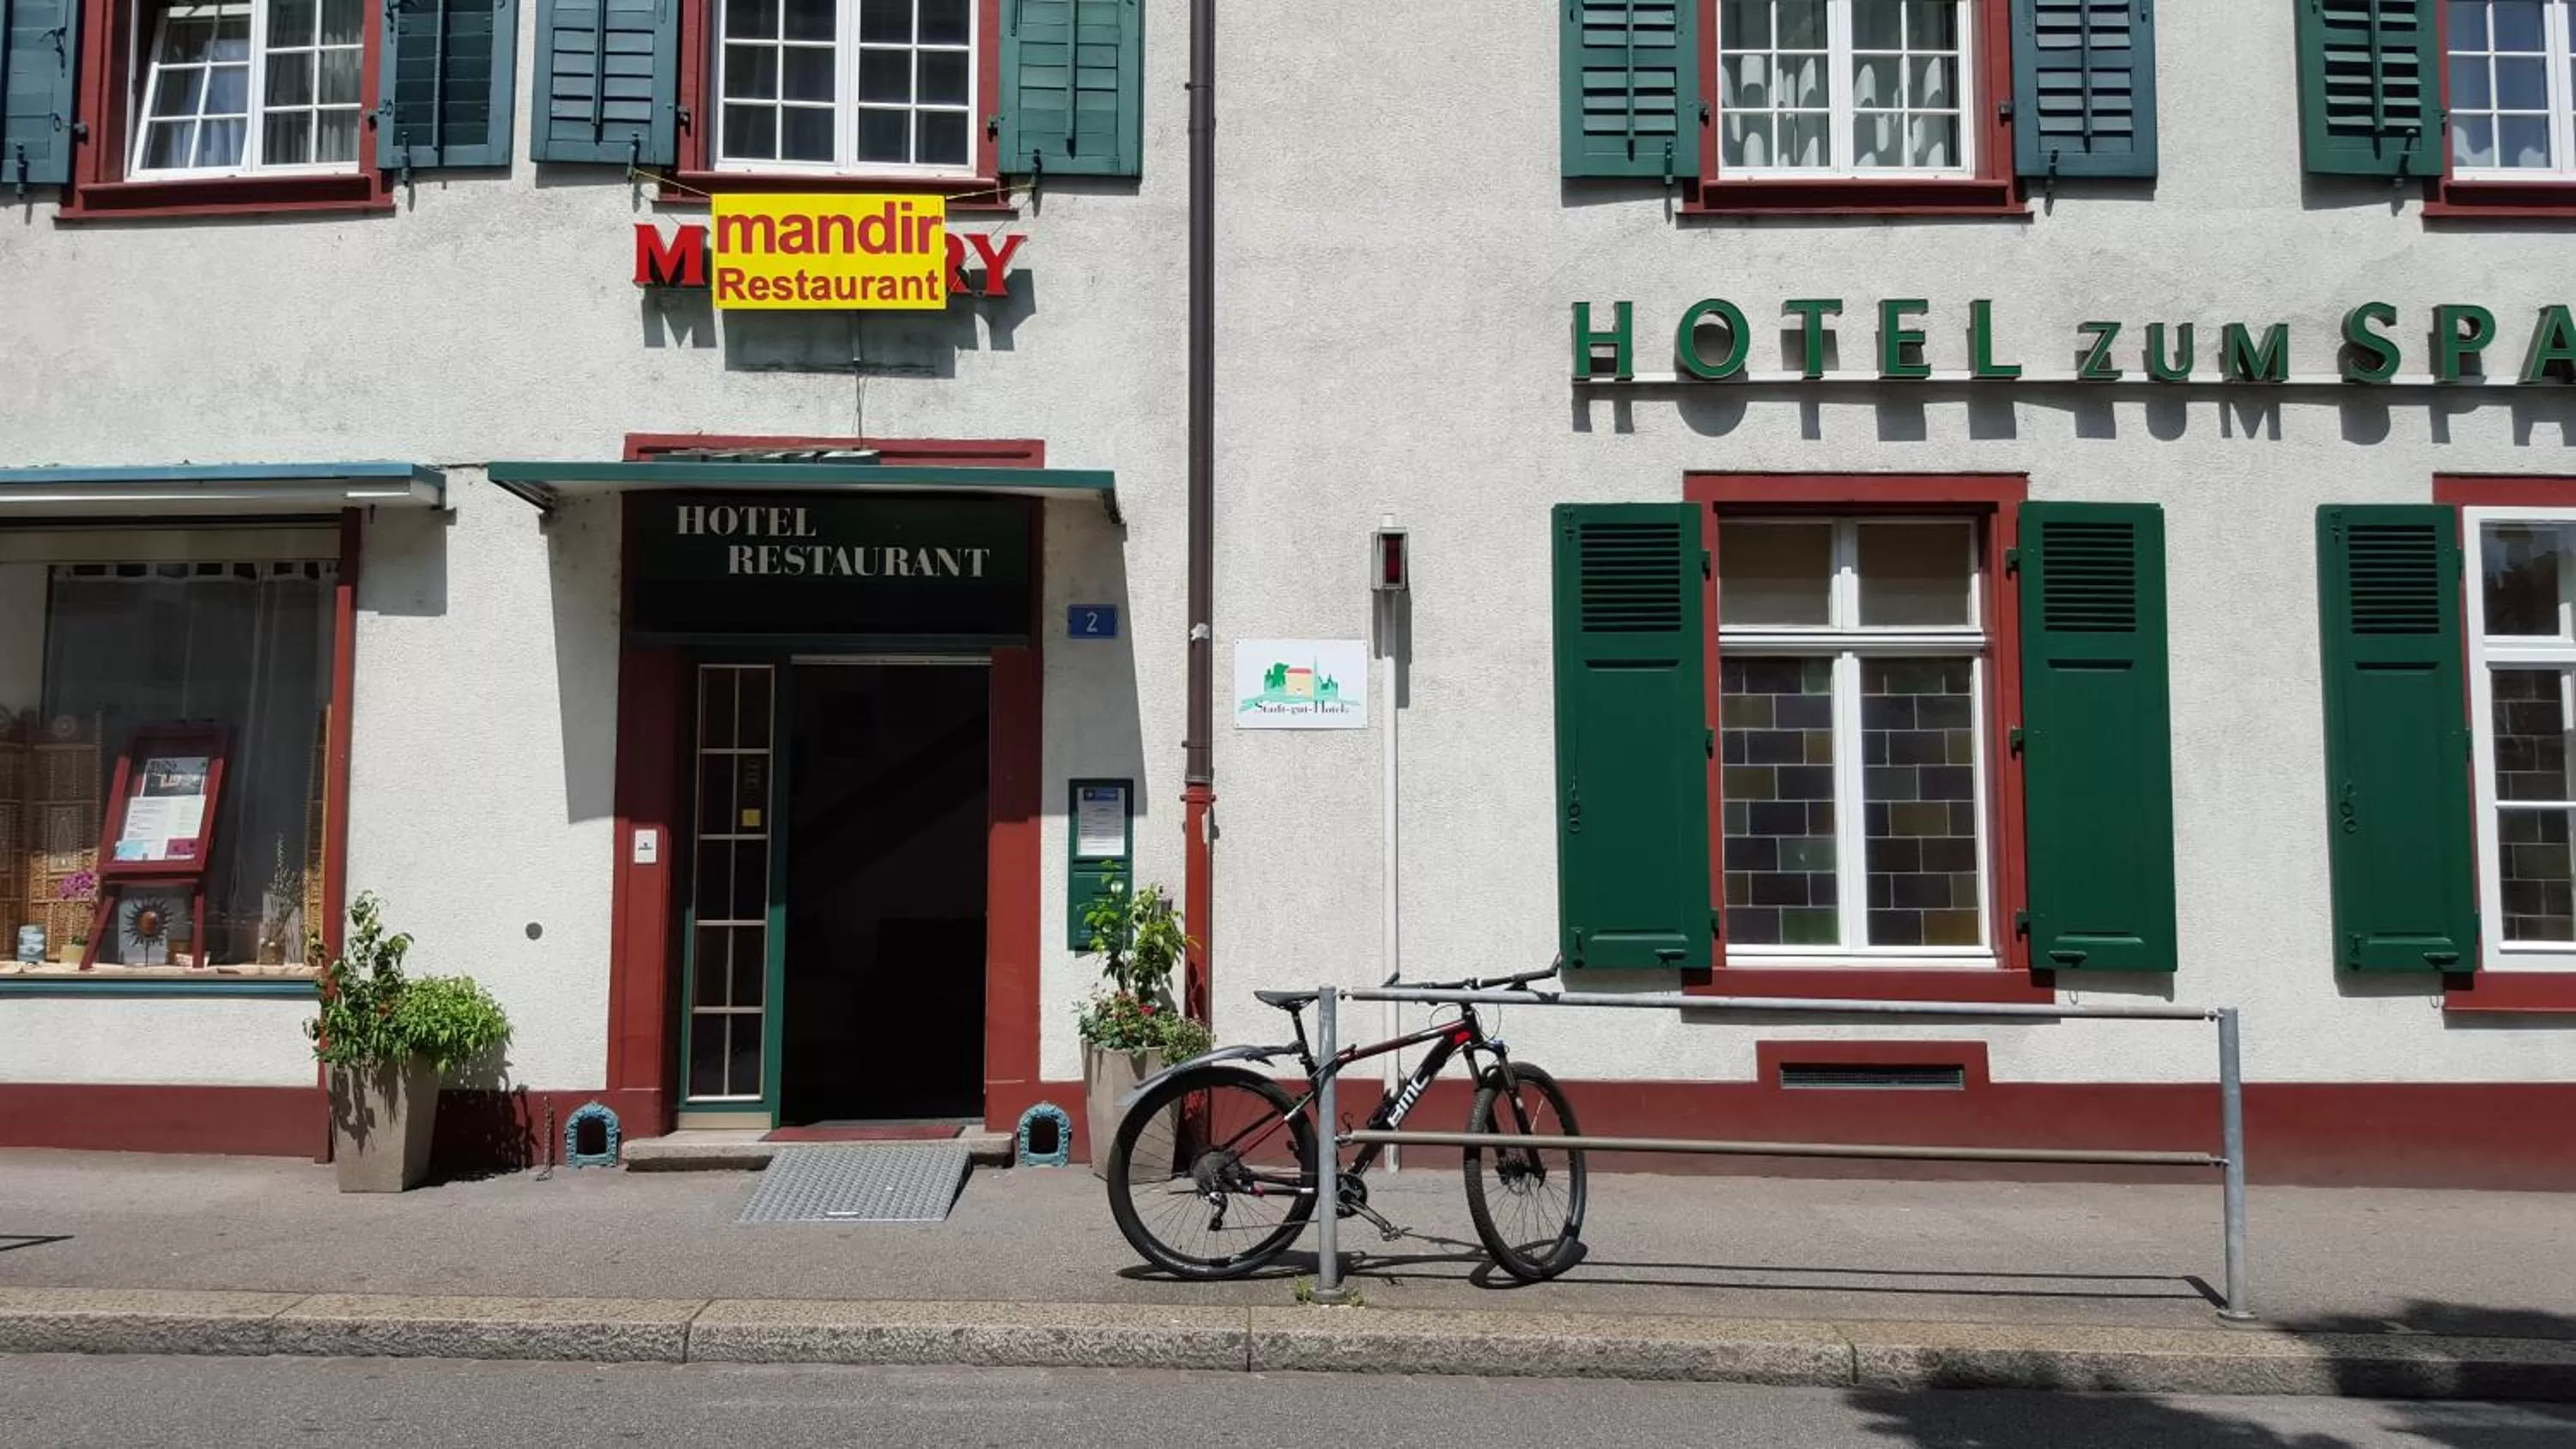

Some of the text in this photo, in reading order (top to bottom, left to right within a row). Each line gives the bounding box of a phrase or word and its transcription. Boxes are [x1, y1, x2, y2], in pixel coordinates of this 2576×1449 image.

[716, 201, 943, 255] mandir
[717, 268, 939, 302] Restaurant
[1571, 297, 2023, 381] HOTEL
[2075, 320, 2289, 383] ZUM
[677, 505, 817, 538] HOTEL
[727, 544, 990, 578] RESTAURANT
[1085, 611, 1098, 633] 2
[1387, 1075, 1430, 1128] BMC
